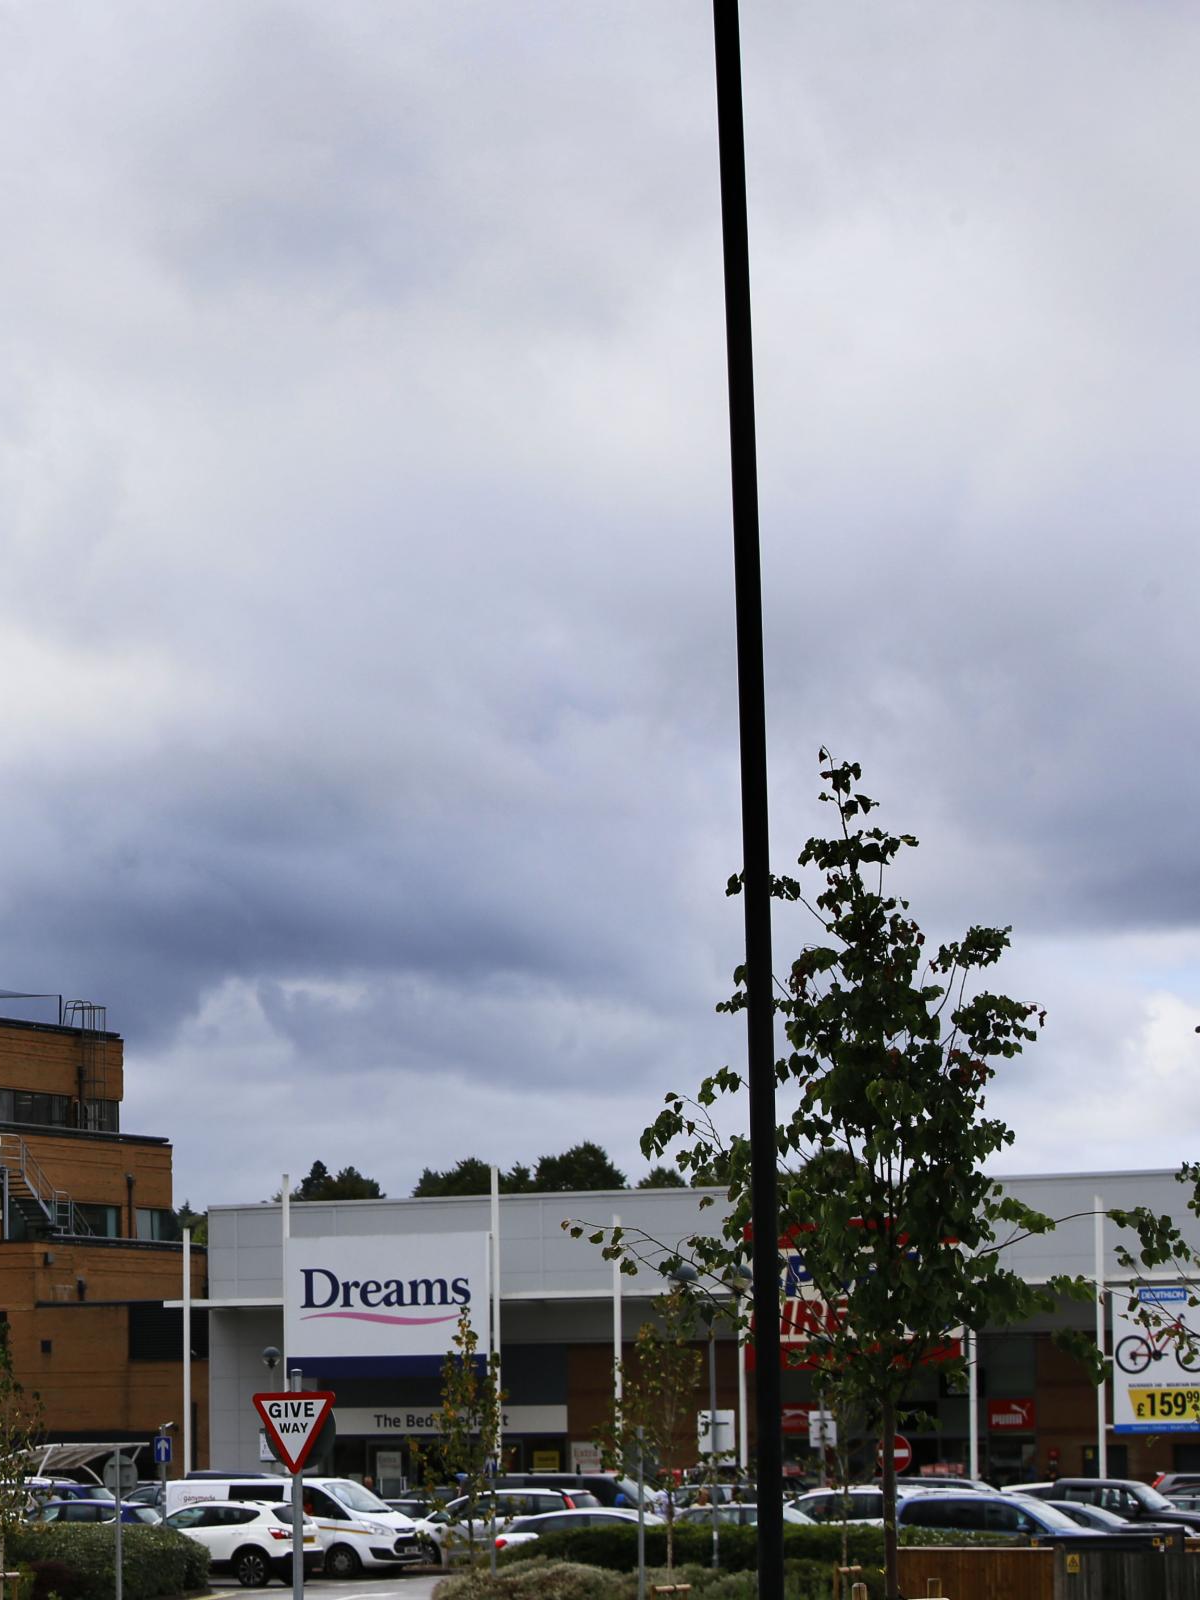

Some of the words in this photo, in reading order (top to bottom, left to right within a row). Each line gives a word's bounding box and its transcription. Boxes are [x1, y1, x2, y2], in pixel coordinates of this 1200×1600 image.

[300, 1268, 471, 1309] Dreams
[268, 1402, 315, 1418] GIVE
[279, 1422, 308, 1433] WAY
[374, 1414, 401, 1427] The
[406, 1414, 433, 1427] Bed
